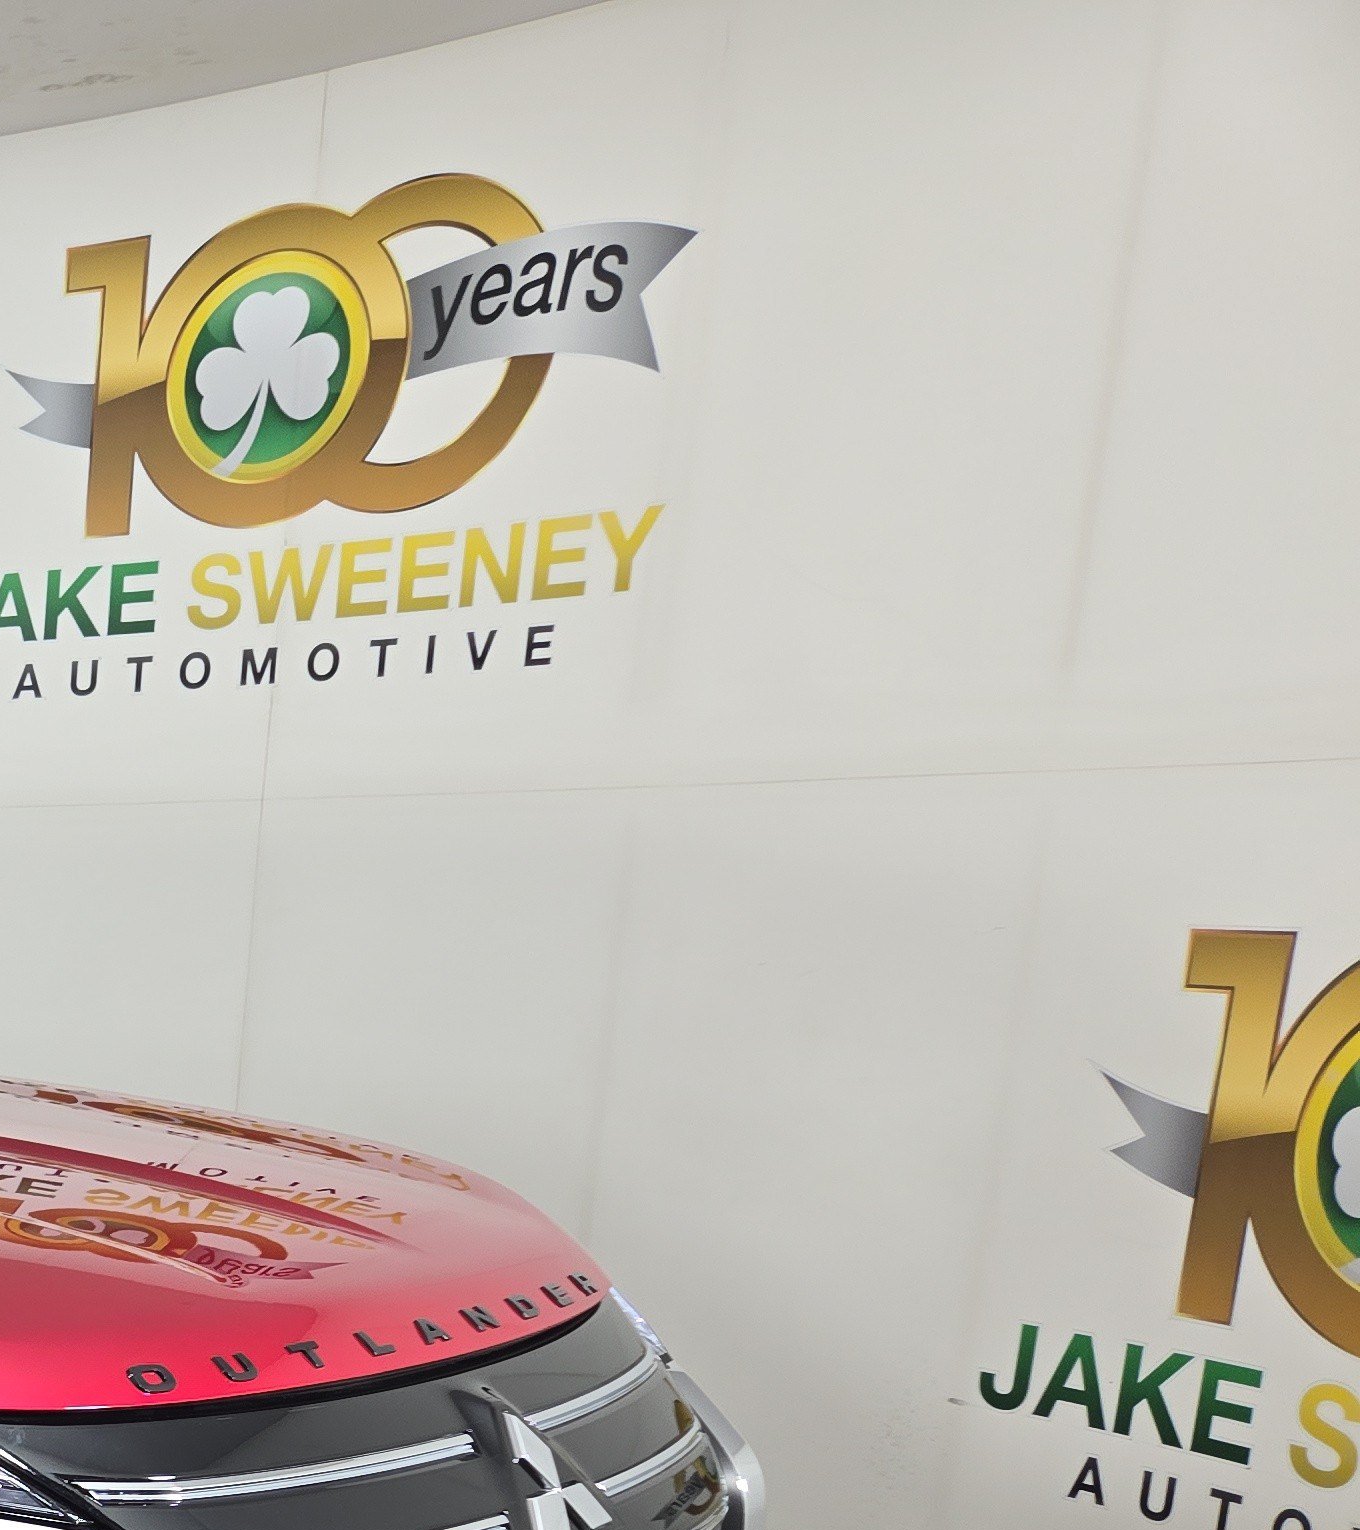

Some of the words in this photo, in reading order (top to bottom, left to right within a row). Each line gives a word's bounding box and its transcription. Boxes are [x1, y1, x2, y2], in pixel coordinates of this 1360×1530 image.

[424, 244, 629, 360] years
[186, 504, 666, 630] SWEENEY
[12, 624, 556, 701] AUTOMOTIVE
[125, 1271, 599, 1395] OUTLANDER
[979, 1323, 1264, 1466] JAKE
